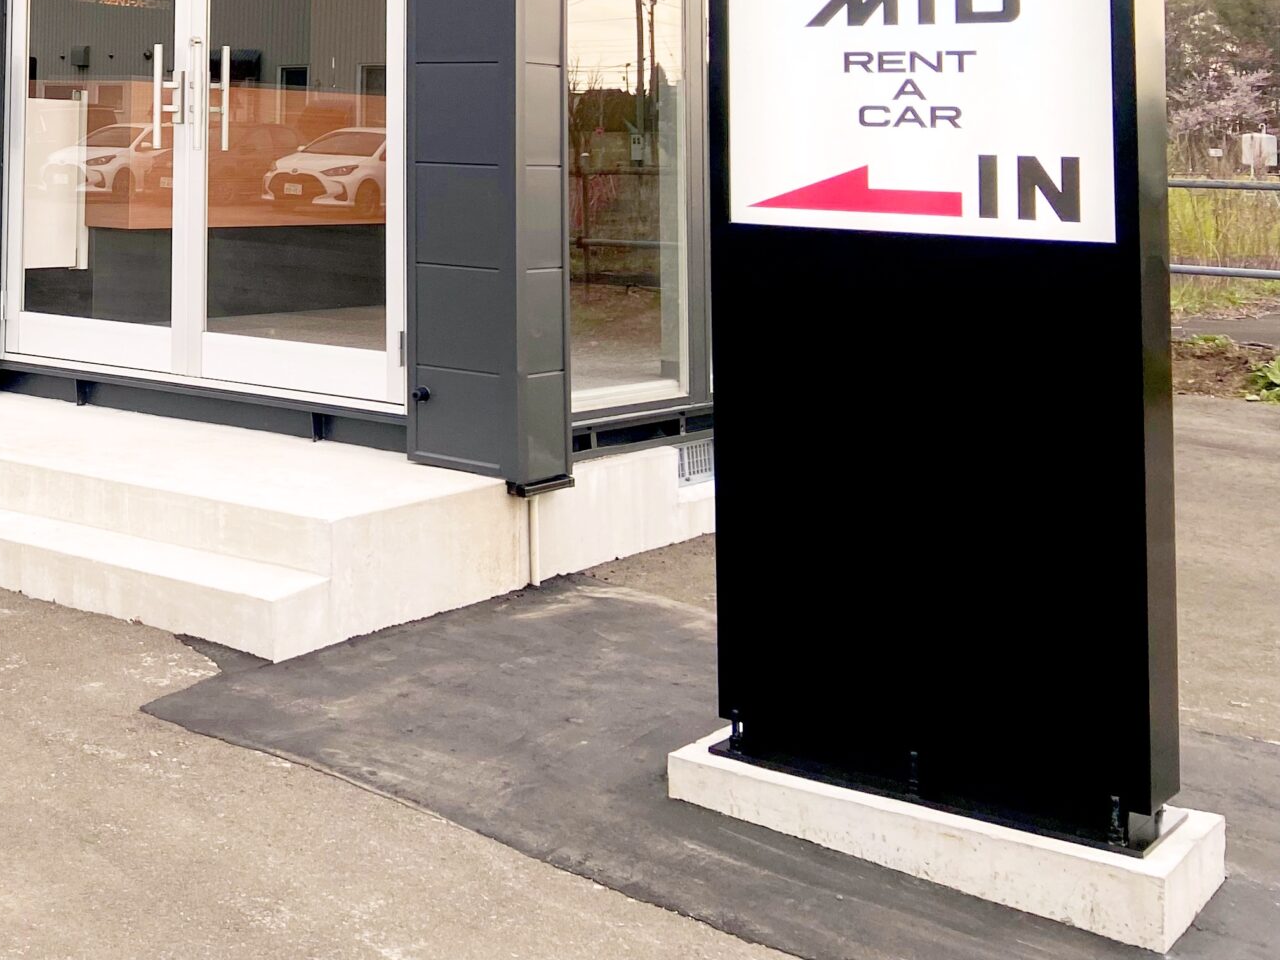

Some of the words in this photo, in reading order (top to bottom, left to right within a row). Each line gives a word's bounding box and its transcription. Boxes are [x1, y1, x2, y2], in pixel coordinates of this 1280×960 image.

[843, 51, 976, 73] RENT
[893, 79, 927, 100] A
[858, 105, 962, 129] CAR
[978, 154, 1081, 223] IN
